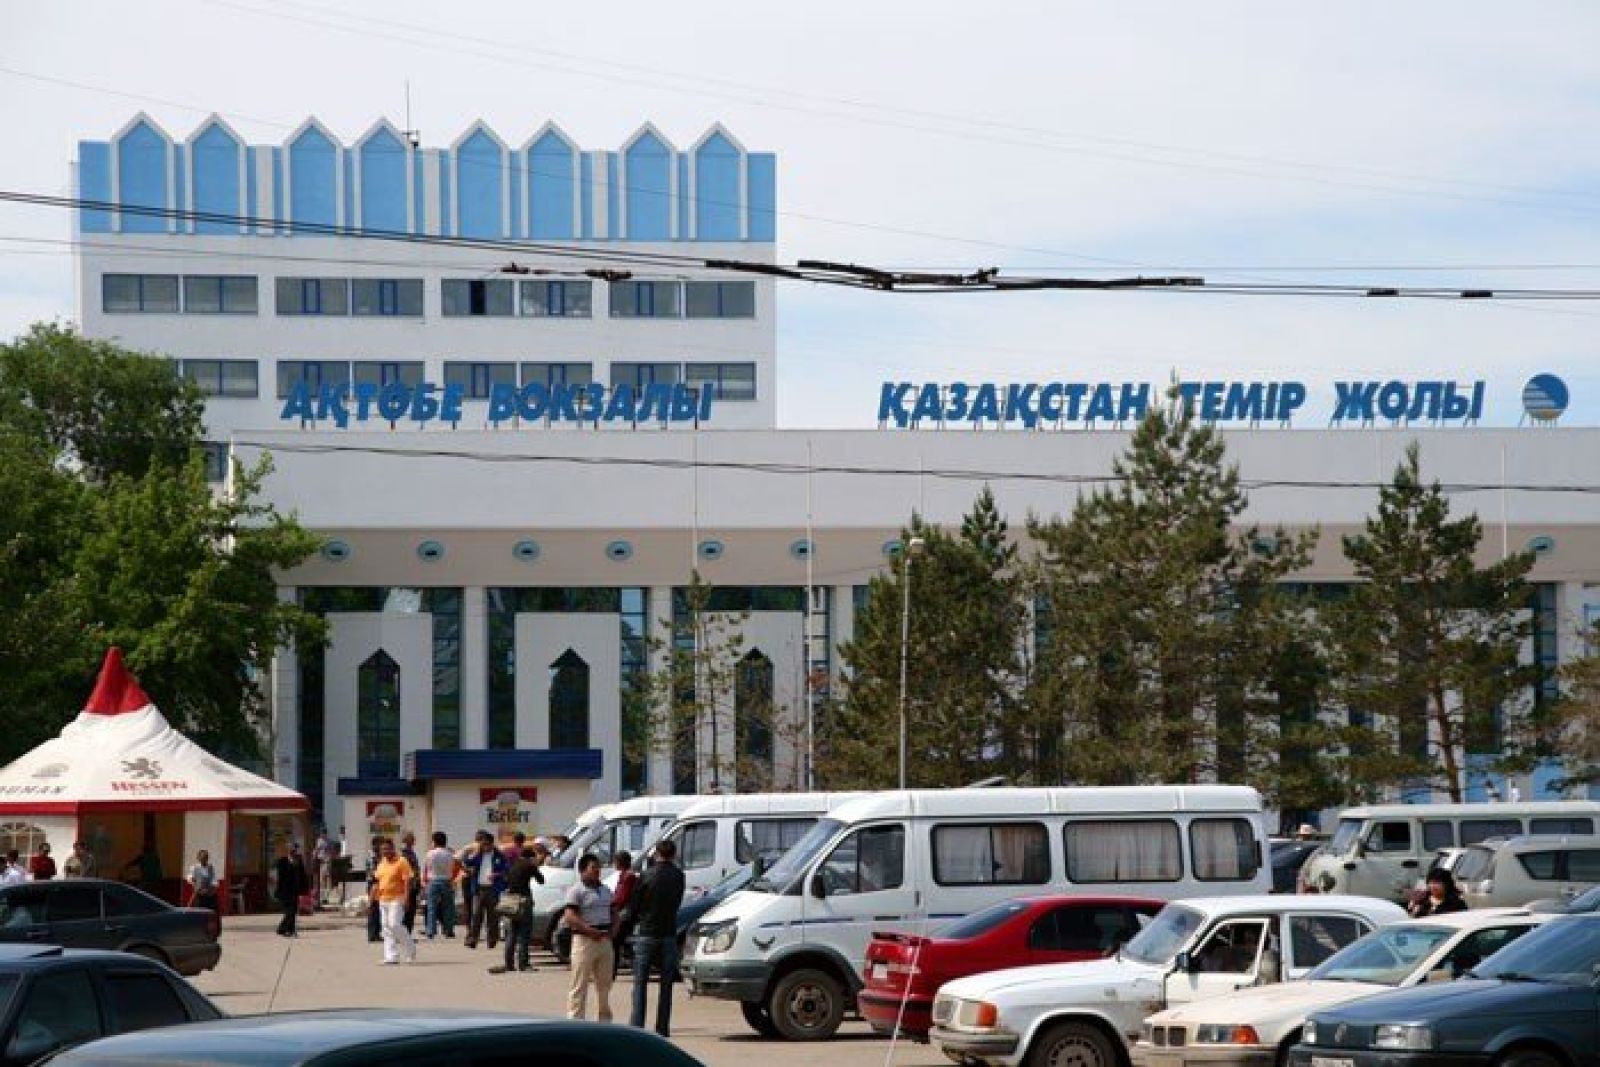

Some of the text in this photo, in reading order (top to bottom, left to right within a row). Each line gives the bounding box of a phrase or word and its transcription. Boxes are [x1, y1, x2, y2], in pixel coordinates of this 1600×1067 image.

[280, 383, 714, 428] АҚТӨБЕ ВОКЗАЛЫ
[879, 380, 1486, 428] ҚАЗАҚСТАН ТЕМІР ЖОЛЫ
